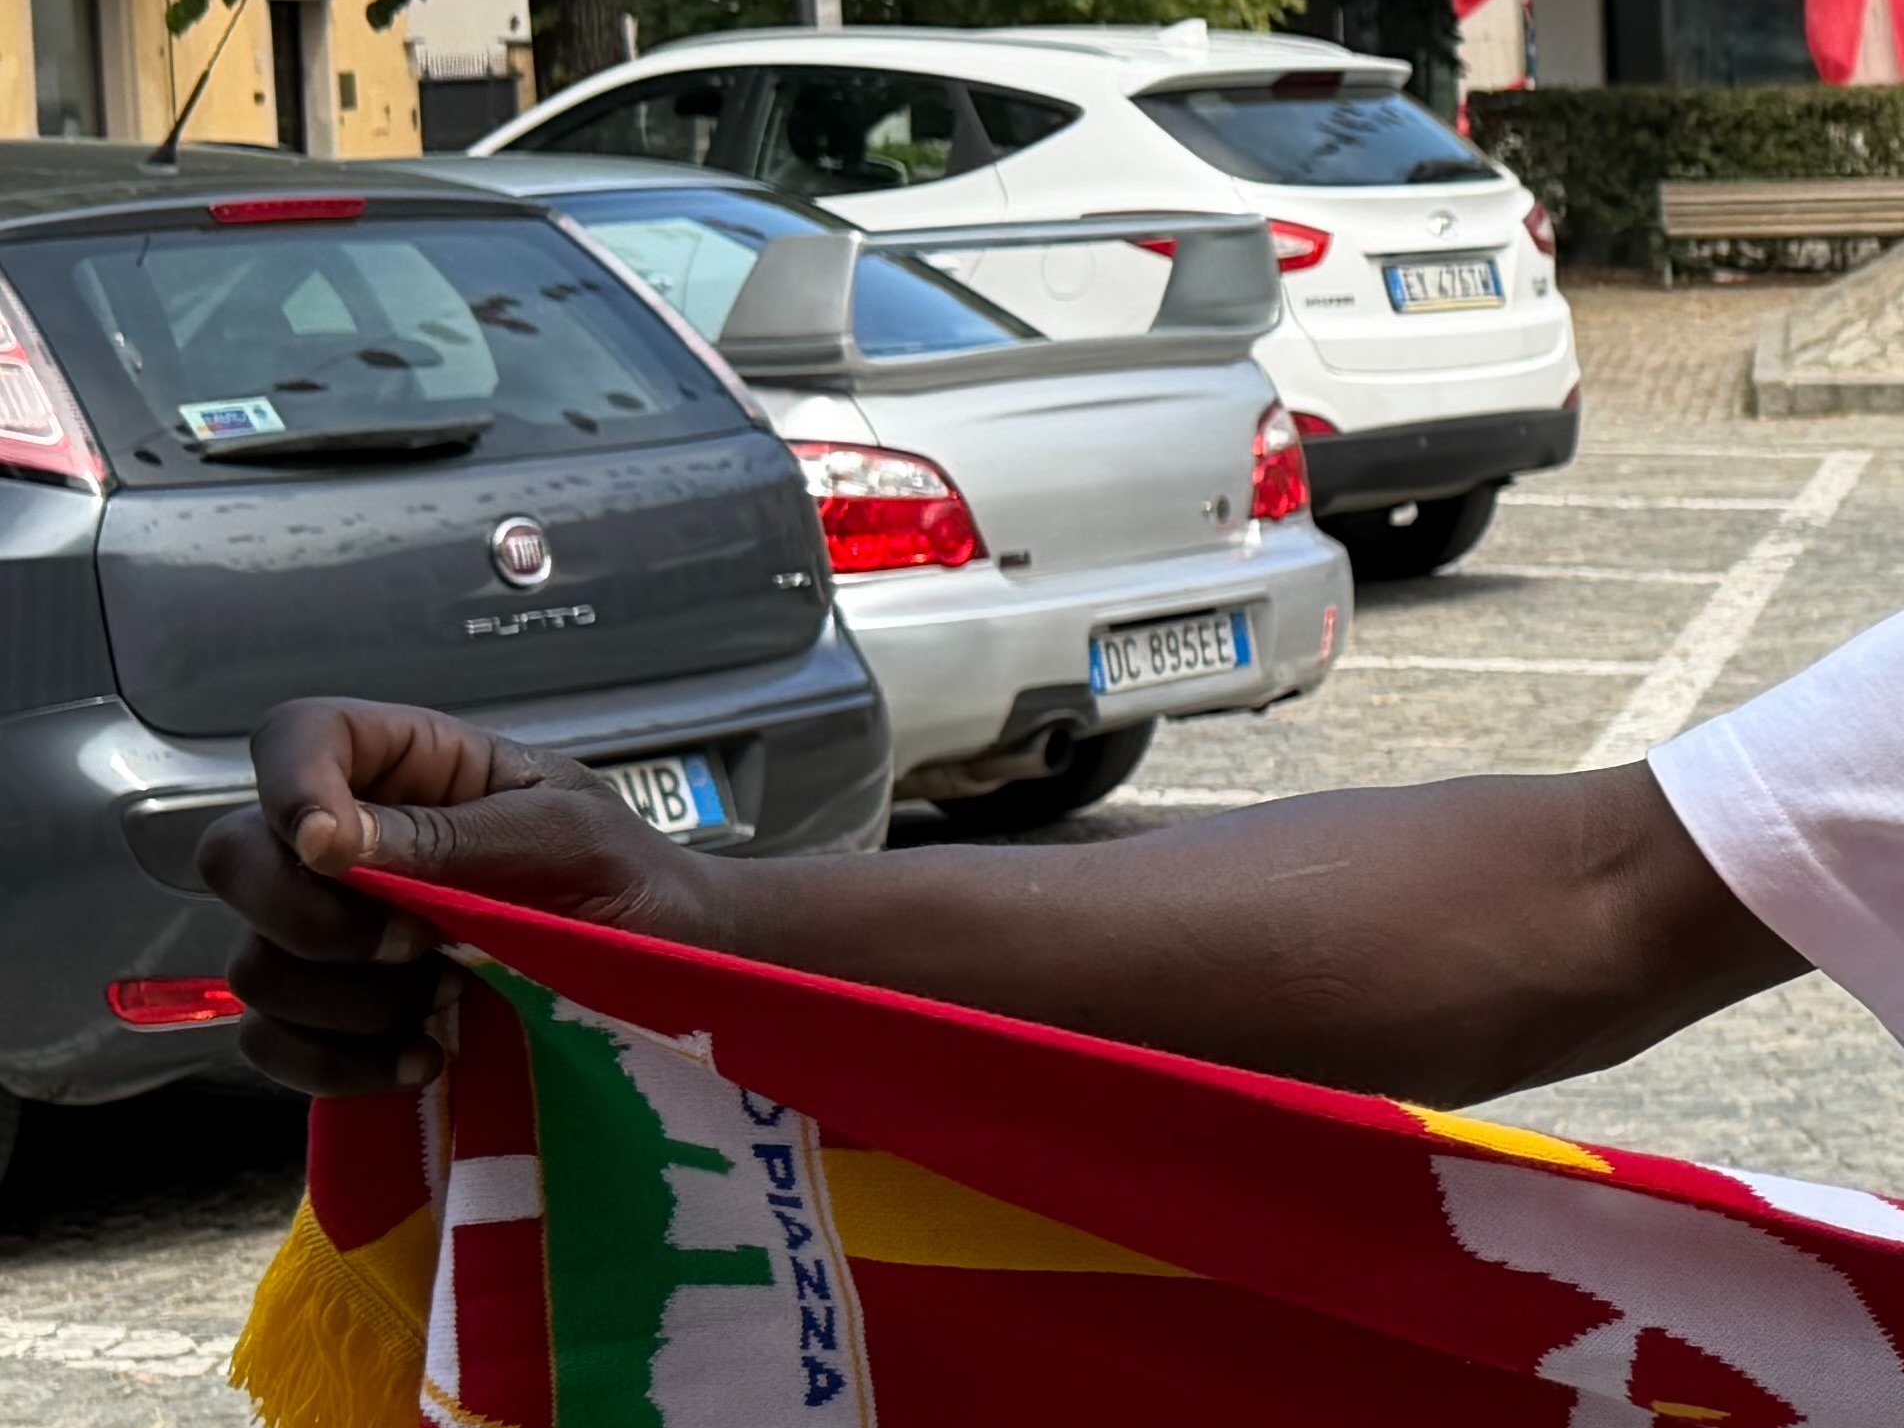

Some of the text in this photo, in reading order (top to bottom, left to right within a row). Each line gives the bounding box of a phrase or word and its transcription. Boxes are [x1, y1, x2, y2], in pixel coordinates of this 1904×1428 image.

[465, 603, 597, 639] PUNTO
[1104, 619, 1233, 686] DC 895EE
[751, 1143, 847, 1408] PIAZZA
